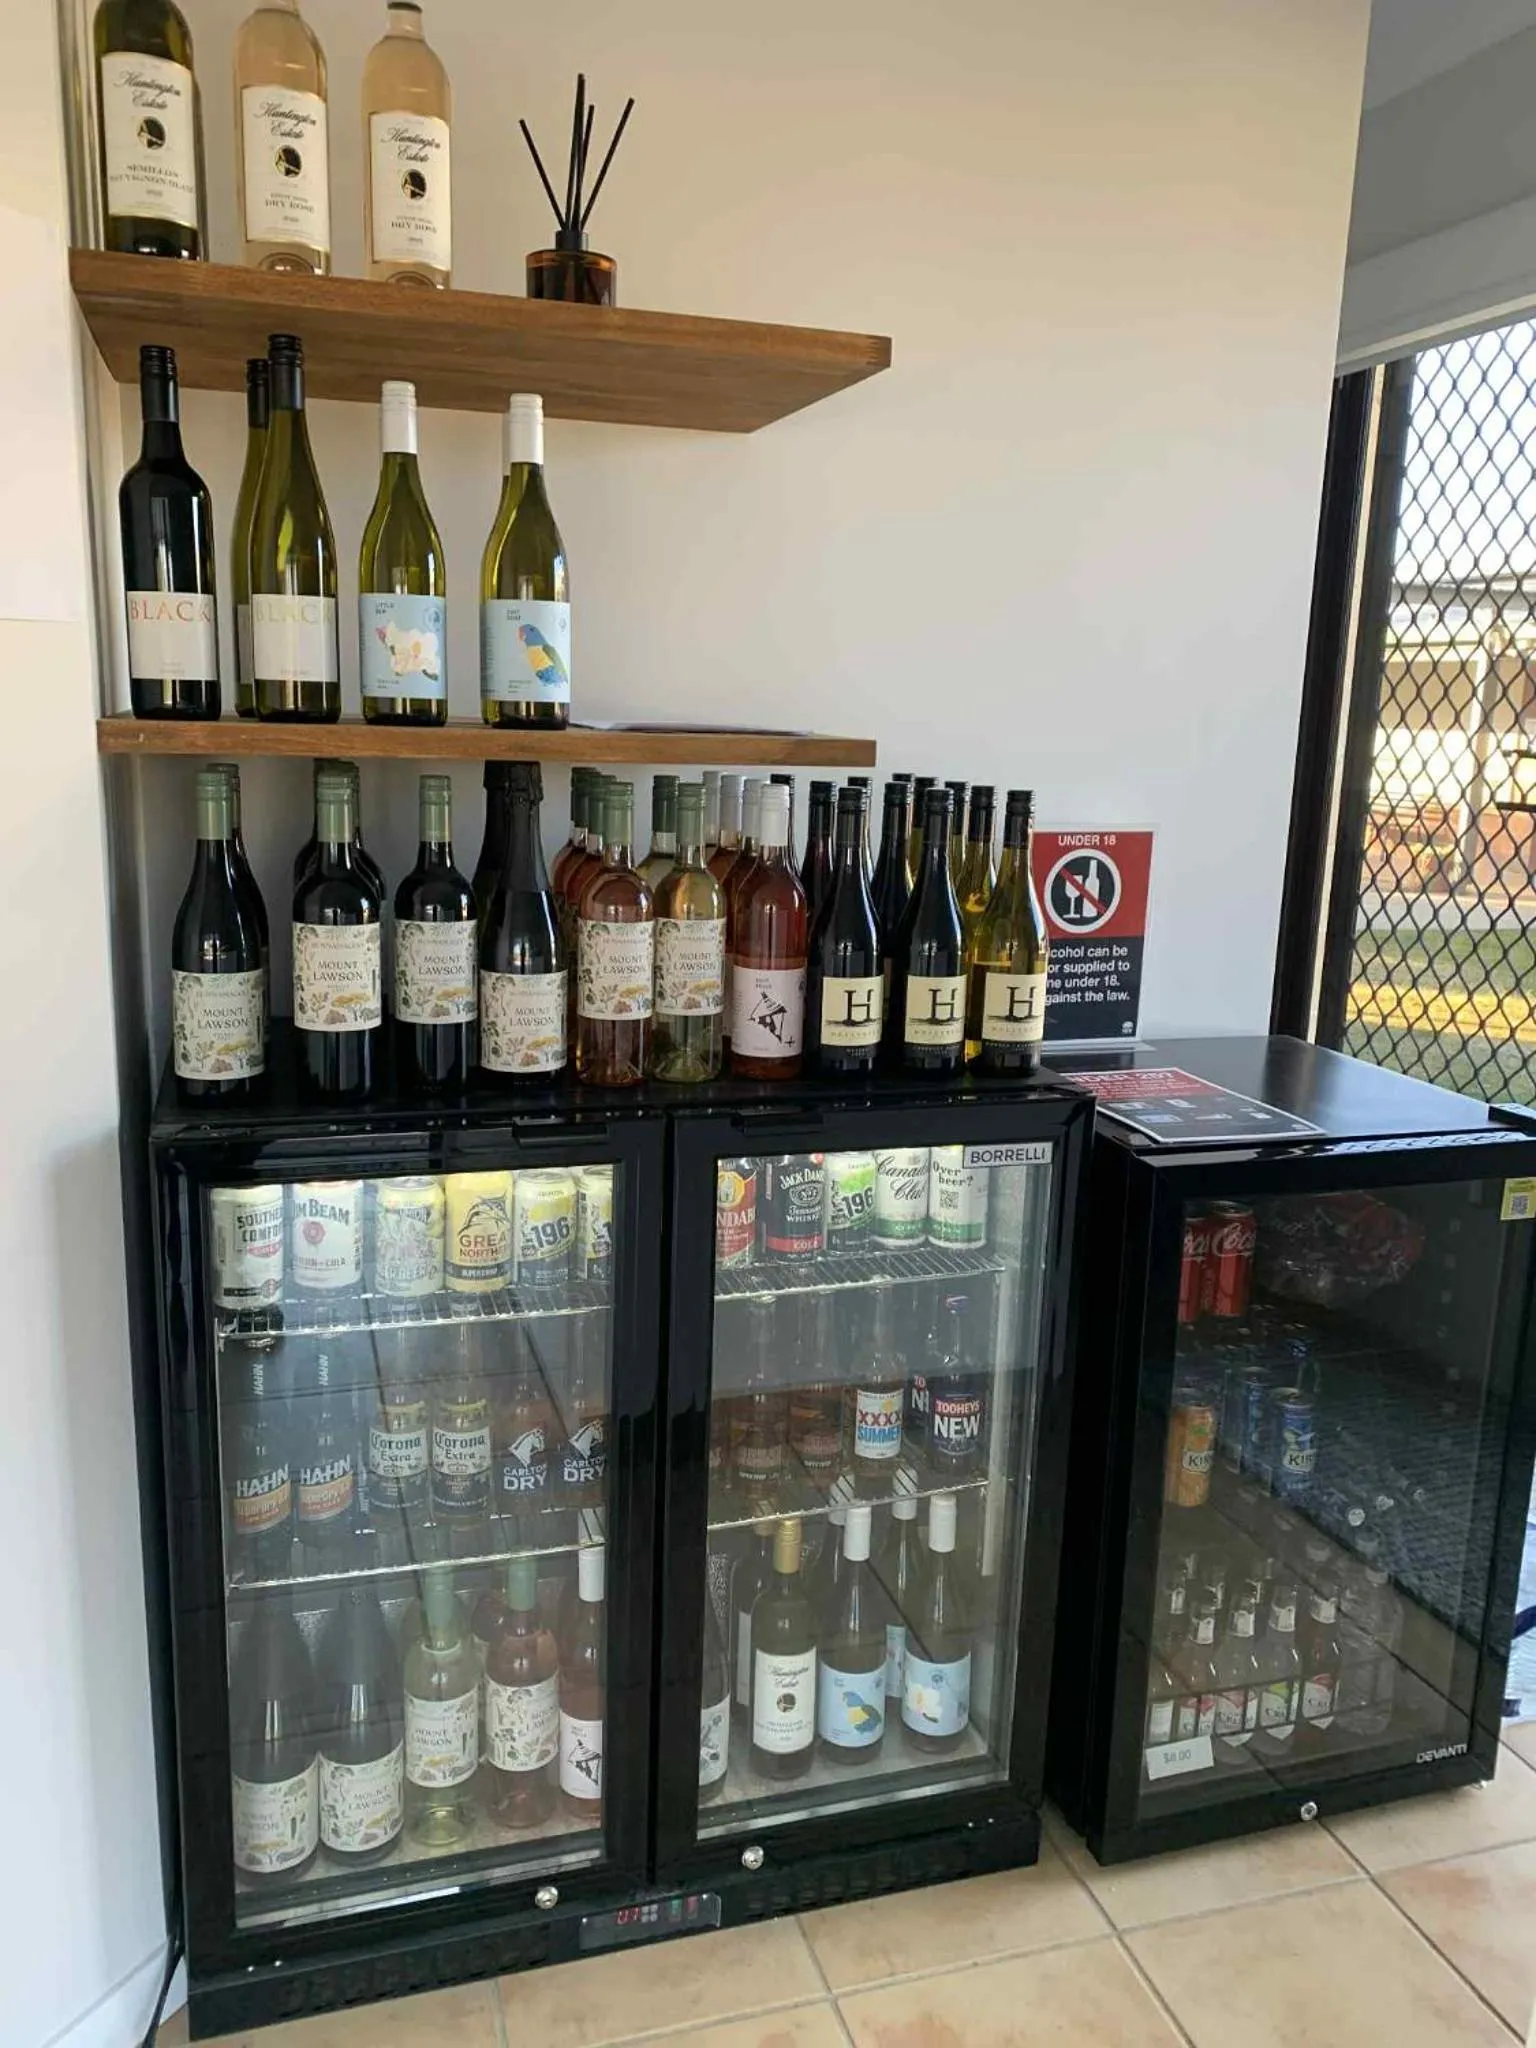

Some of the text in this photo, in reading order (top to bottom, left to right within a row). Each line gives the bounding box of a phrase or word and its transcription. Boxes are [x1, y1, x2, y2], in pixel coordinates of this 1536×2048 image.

[129, 598, 212, 623] BLACK
[254, 601, 335, 626] BLACK
[1057, 834, 1117, 847] UNDER 18
[1087, 947, 1110, 957] can
[1112, 944, 1129, 957] be
[317, 960, 358, 970] MOUNT
[424, 954, 461, 964] MOUNT
[312, 970, 363, 981] LAWSON
[418, 966, 466, 976] LAWSON
[1063, 960, 1116, 976] supplied
[1117, 960, 1131, 972] to
[1064, 975, 1101, 988] under
[1103, 974, 1121, 987] 18.
[1084, 989, 1105, 1002] the
[1106, 989, 1131, 1001] law.
[200, 1006, 243, 1017] MOUNT
[197, 1017, 249, 1030] LAWSON
[970, 1147, 1046, 1164] BORRELLI
[780, 1171, 804, 1190] JACK
[309, 1197, 350, 1227] BEAM
[935, 1399, 981, 1415] TOOHEYS
[933, 1413, 981, 1439] NEW
[370, 1431, 421, 1451] Corona
[434, 1431, 485, 1450] Corona
[380, 1450, 412, 1462] Extra
[445, 1448, 476, 1460] Extra
[300, 1453, 351, 1485] HAHN
[563, 1464, 605, 1483] DRY
[236, 1462, 289, 1498] HAHN
[503, 1471, 548, 1491] DRY
[1415, 1743, 1468, 1764] DEVANTI
